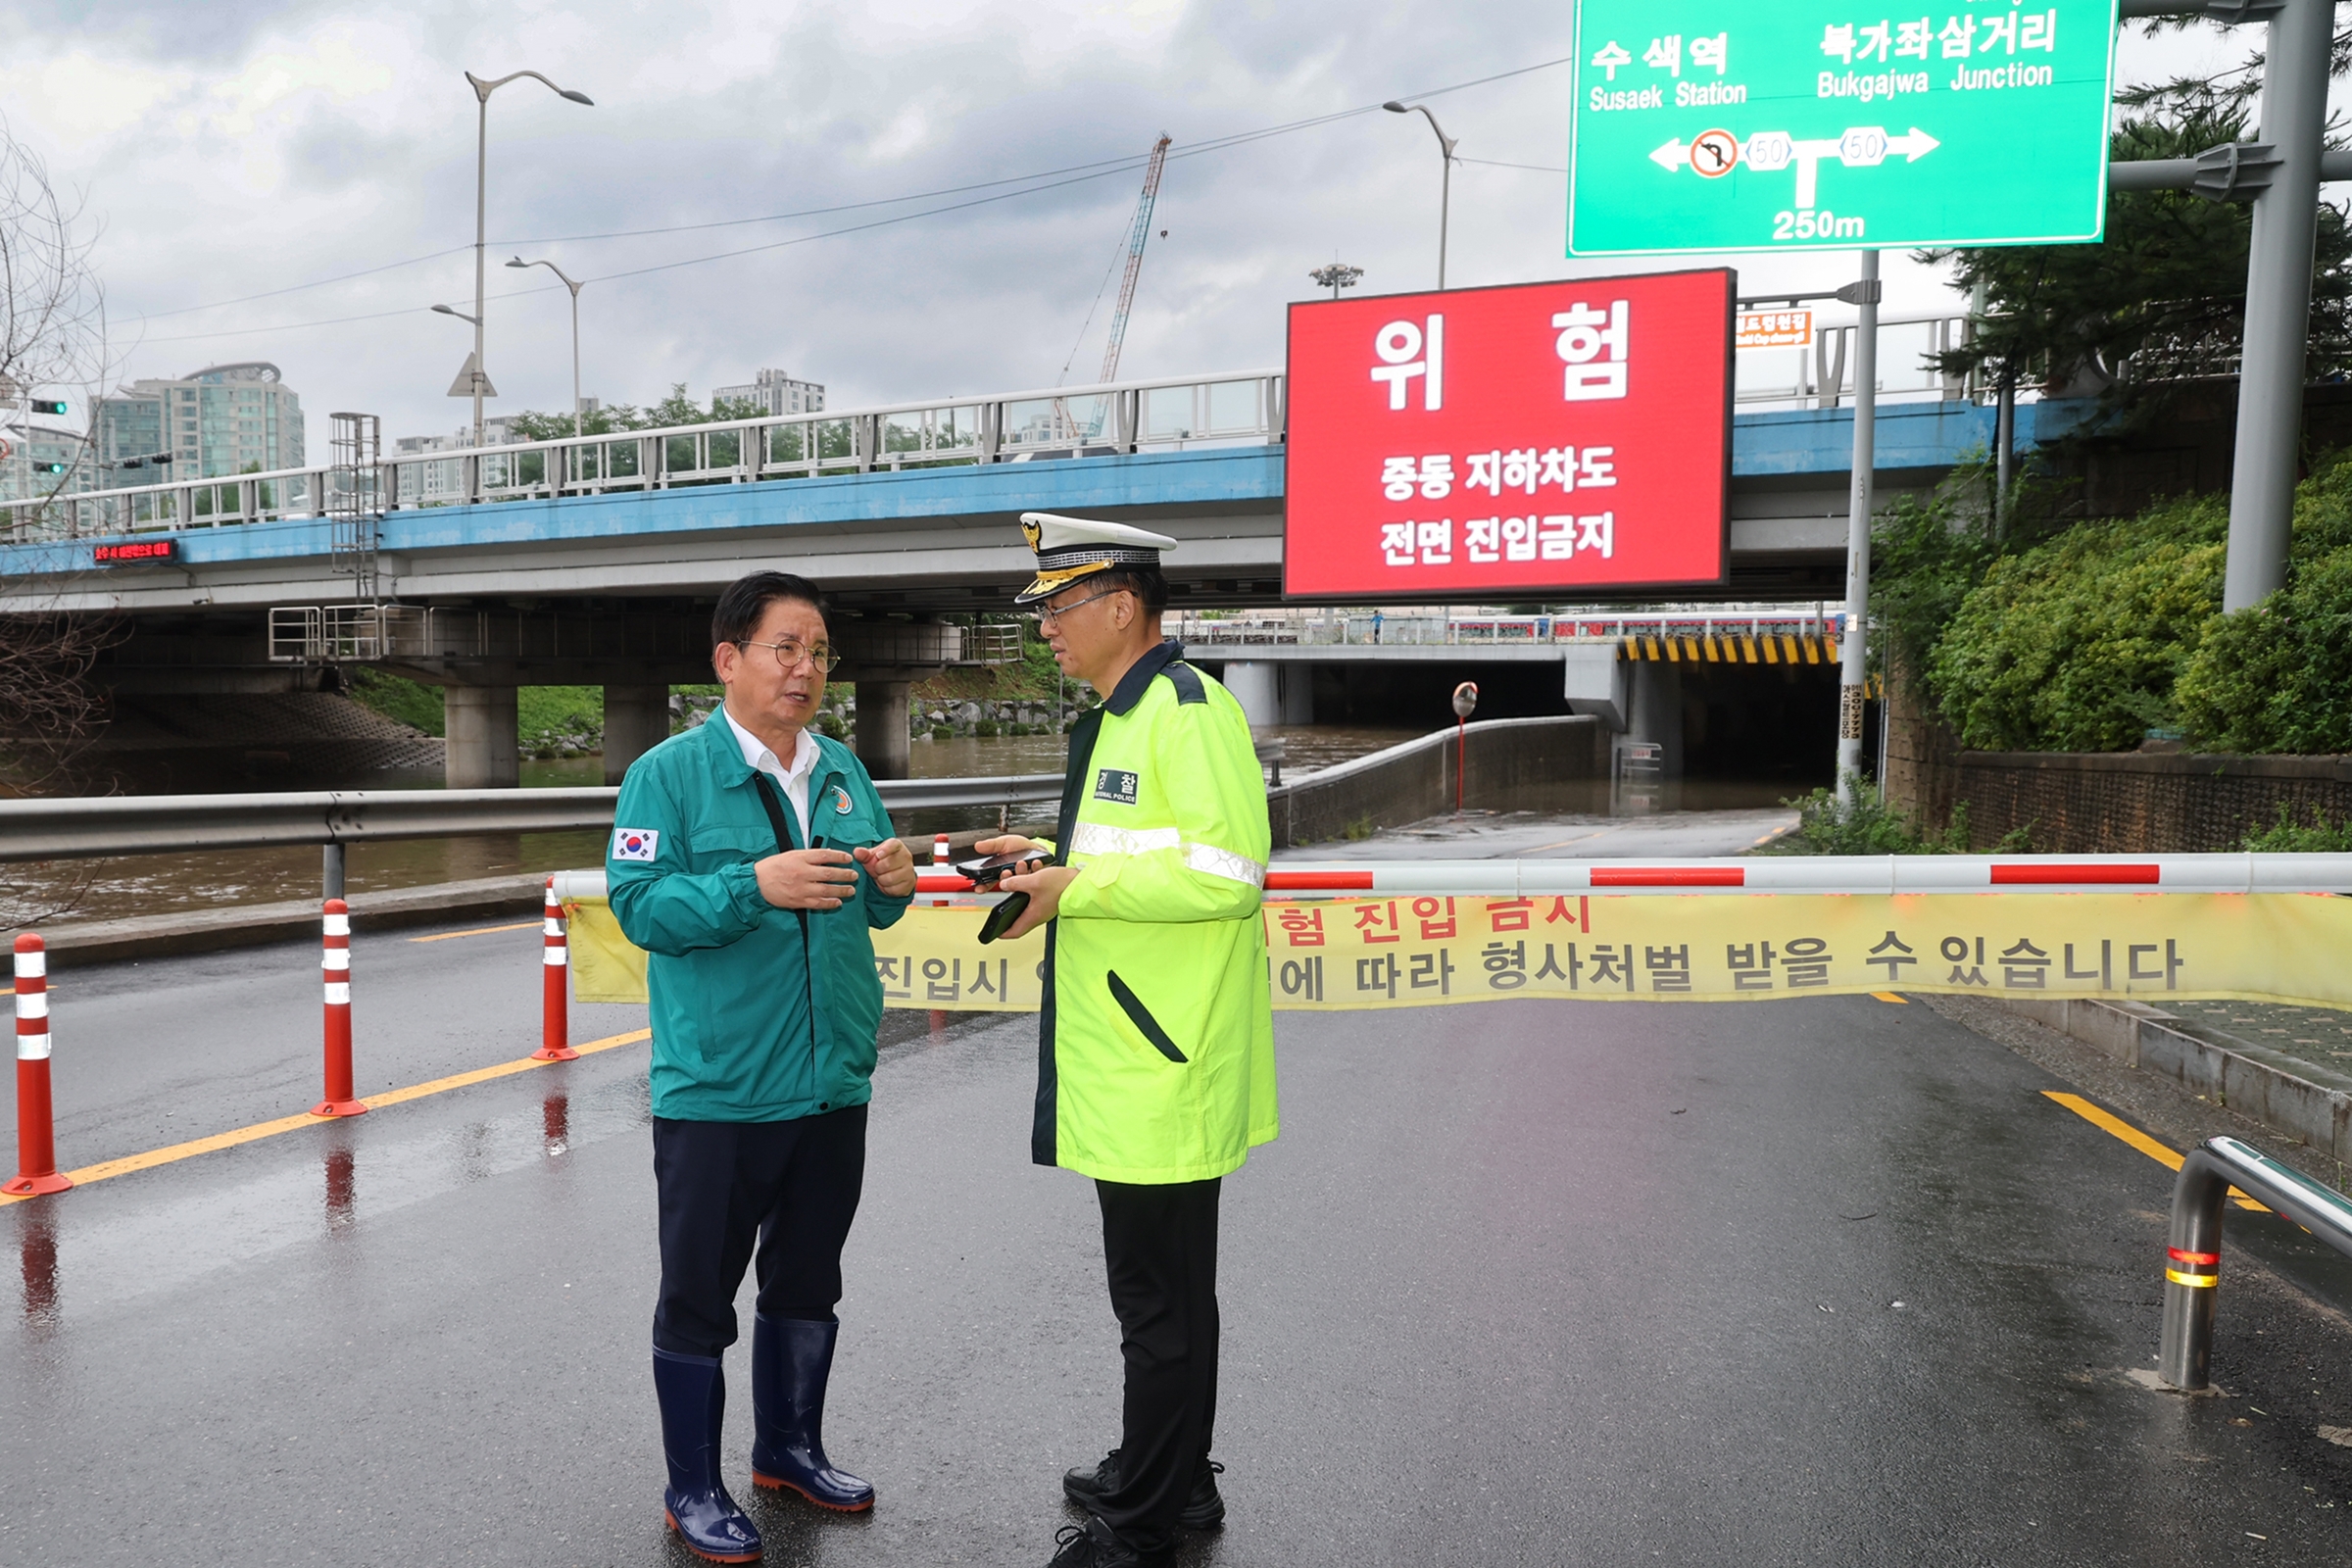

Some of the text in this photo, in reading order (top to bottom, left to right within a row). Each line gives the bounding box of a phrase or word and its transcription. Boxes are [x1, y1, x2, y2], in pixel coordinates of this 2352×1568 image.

[1591, 32, 1728, 80] 수색역
[1820, 8, 2056, 64] 북가좌삼거리
[1590, 80, 1747, 112] Susaek Station
[1818, 62, 2053, 102] Bukgajwa Junction
[1755, 139, 1783, 163] 50
[1850, 134, 1878, 159] 50
[1773, 211, 1864, 240] 250m
[1381, 446, 1617, 501] 중동 지하차도
[1380, 512, 1613, 565] 전면 진입금지
[1262, 908, 1324, 947] 험
[1355, 897, 1455, 944] 진입
[875, 956, 1007, 1002] 진입시
[1267, 956, 1323, 1002] 에
[1356, 949, 1455, 999] 따라
[1482, 940, 1691, 992] 형사처벌
[1727, 937, 1833, 990] 받을
[1866, 931, 1918, 980] 수
[1941, 937, 2184, 990] 있습니다
